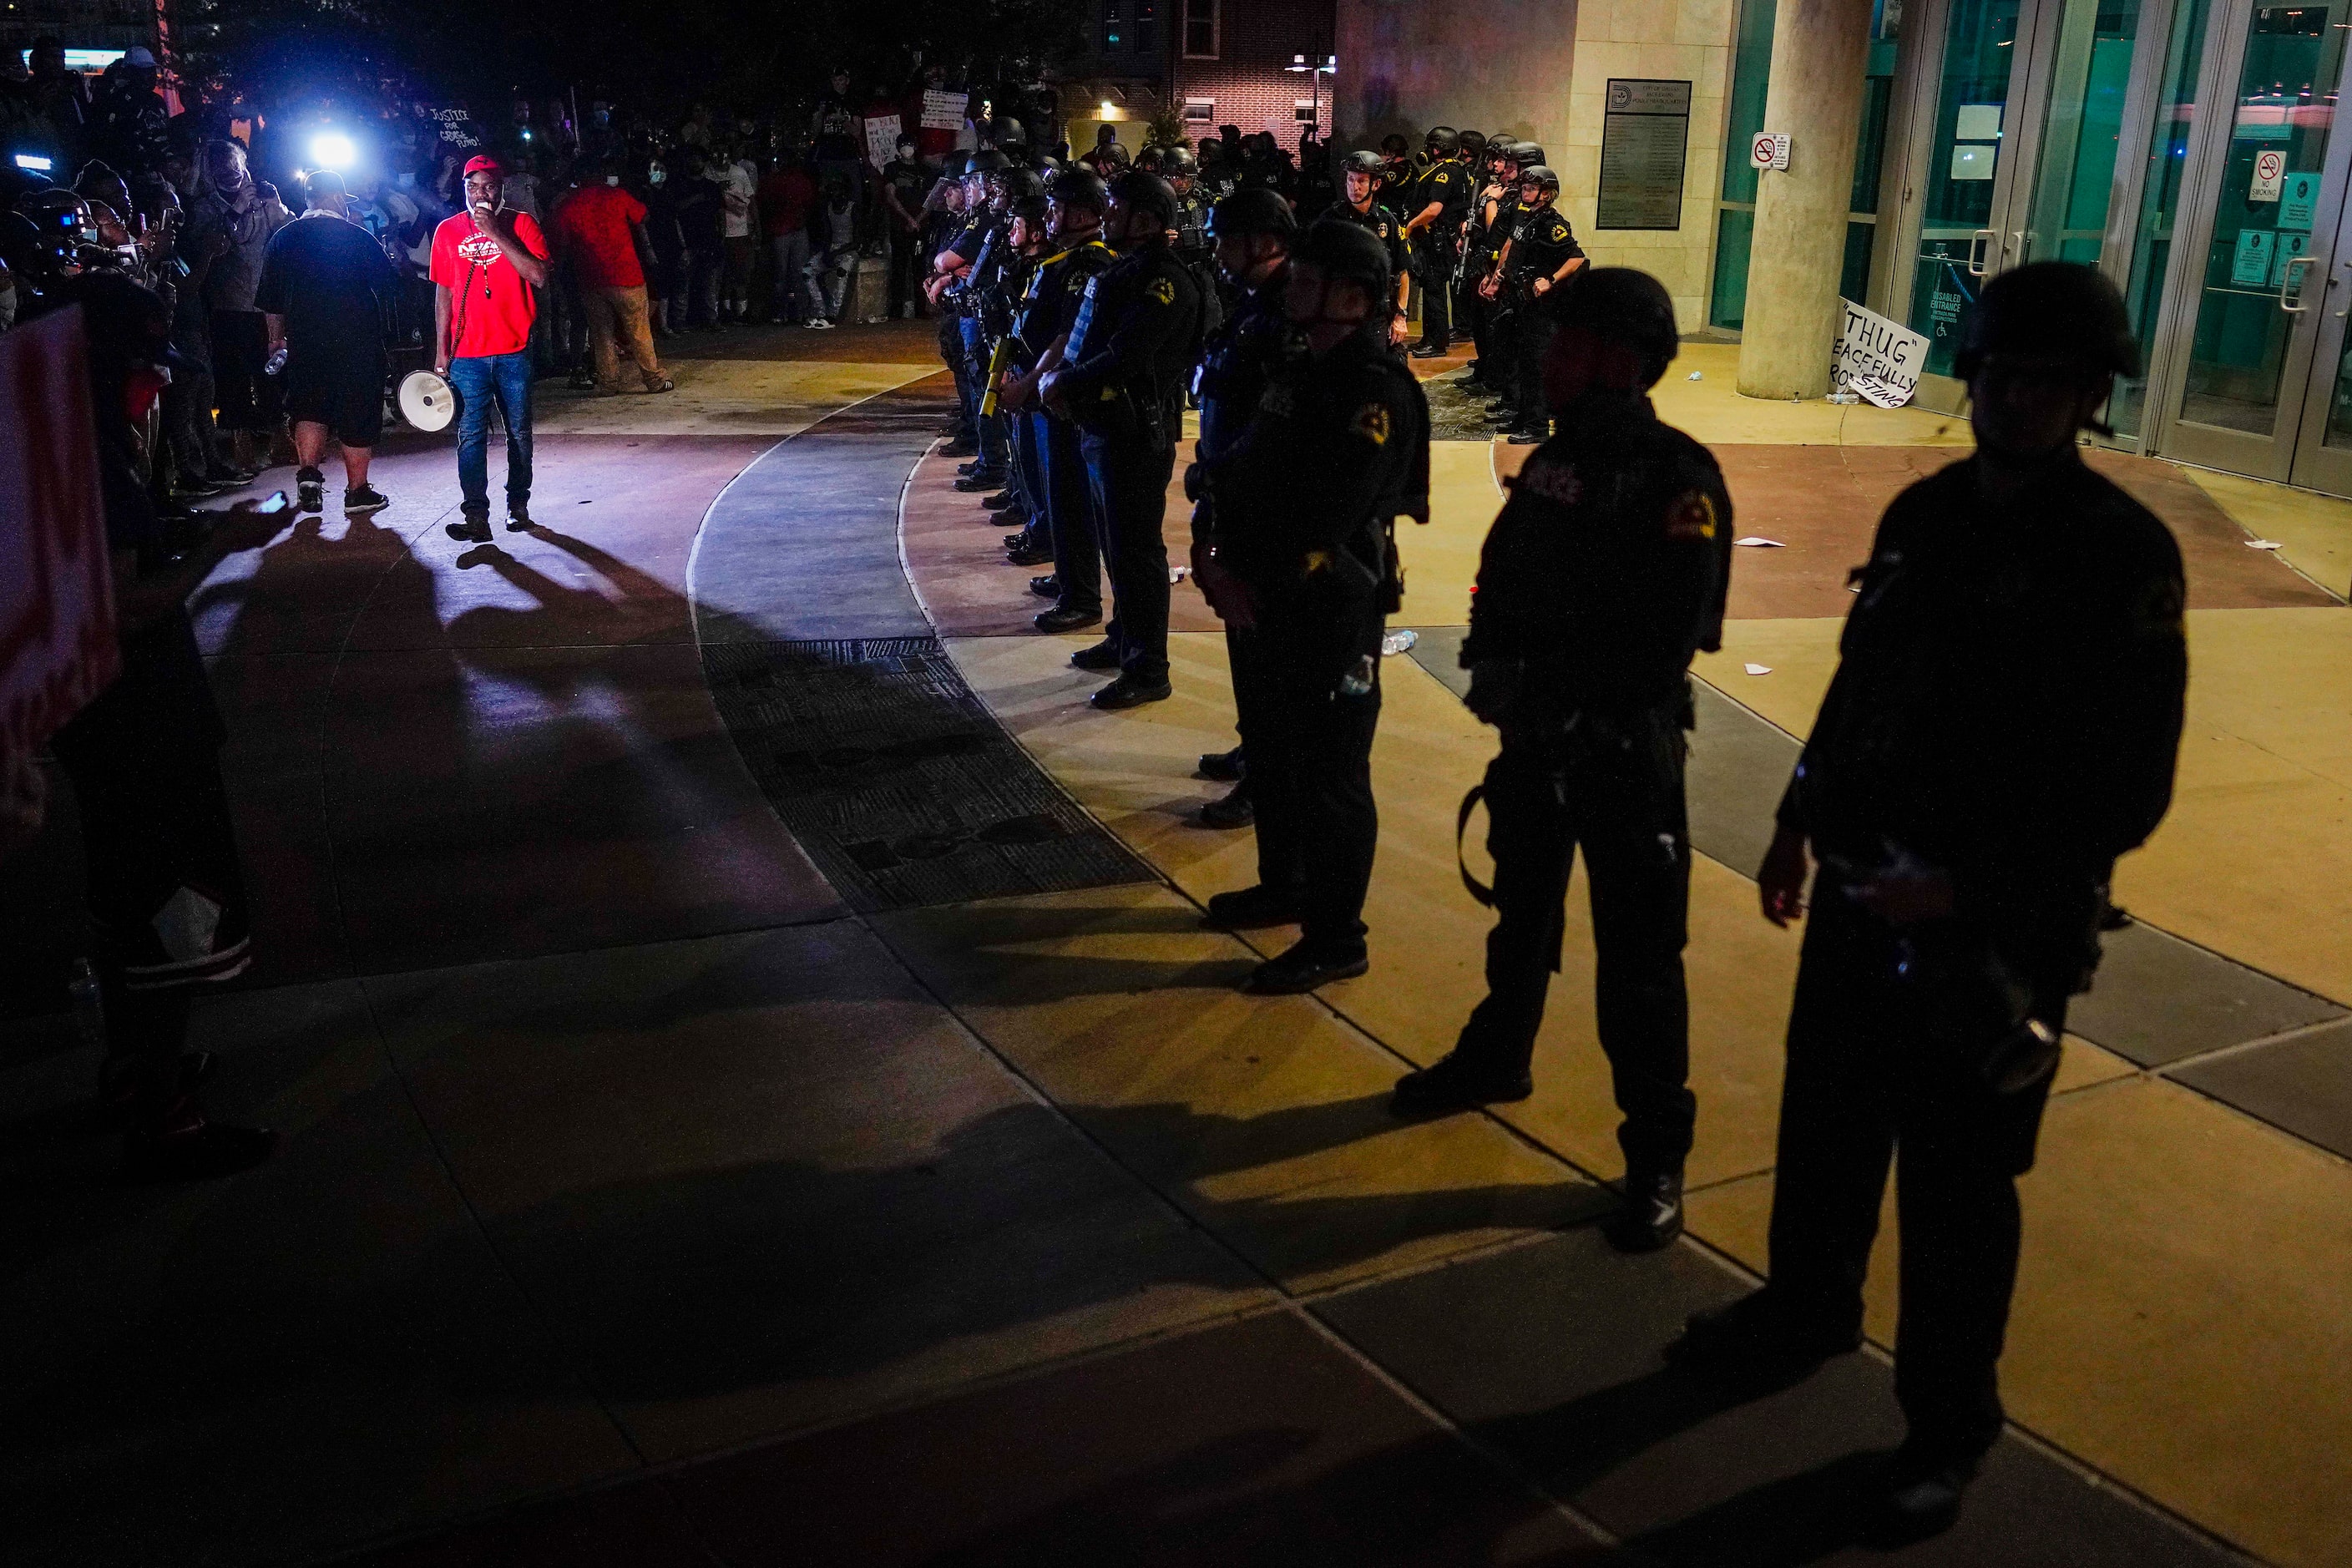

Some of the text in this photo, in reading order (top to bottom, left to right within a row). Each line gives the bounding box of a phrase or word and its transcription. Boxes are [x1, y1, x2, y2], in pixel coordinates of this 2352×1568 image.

[2251, 188, 2277, 196] SMOKING
[1932, 291, 1961, 303] DISABLED
[1930, 300, 1961, 313] ENTRANCE
[1832, 336, 1917, 394] EACEFULLY
